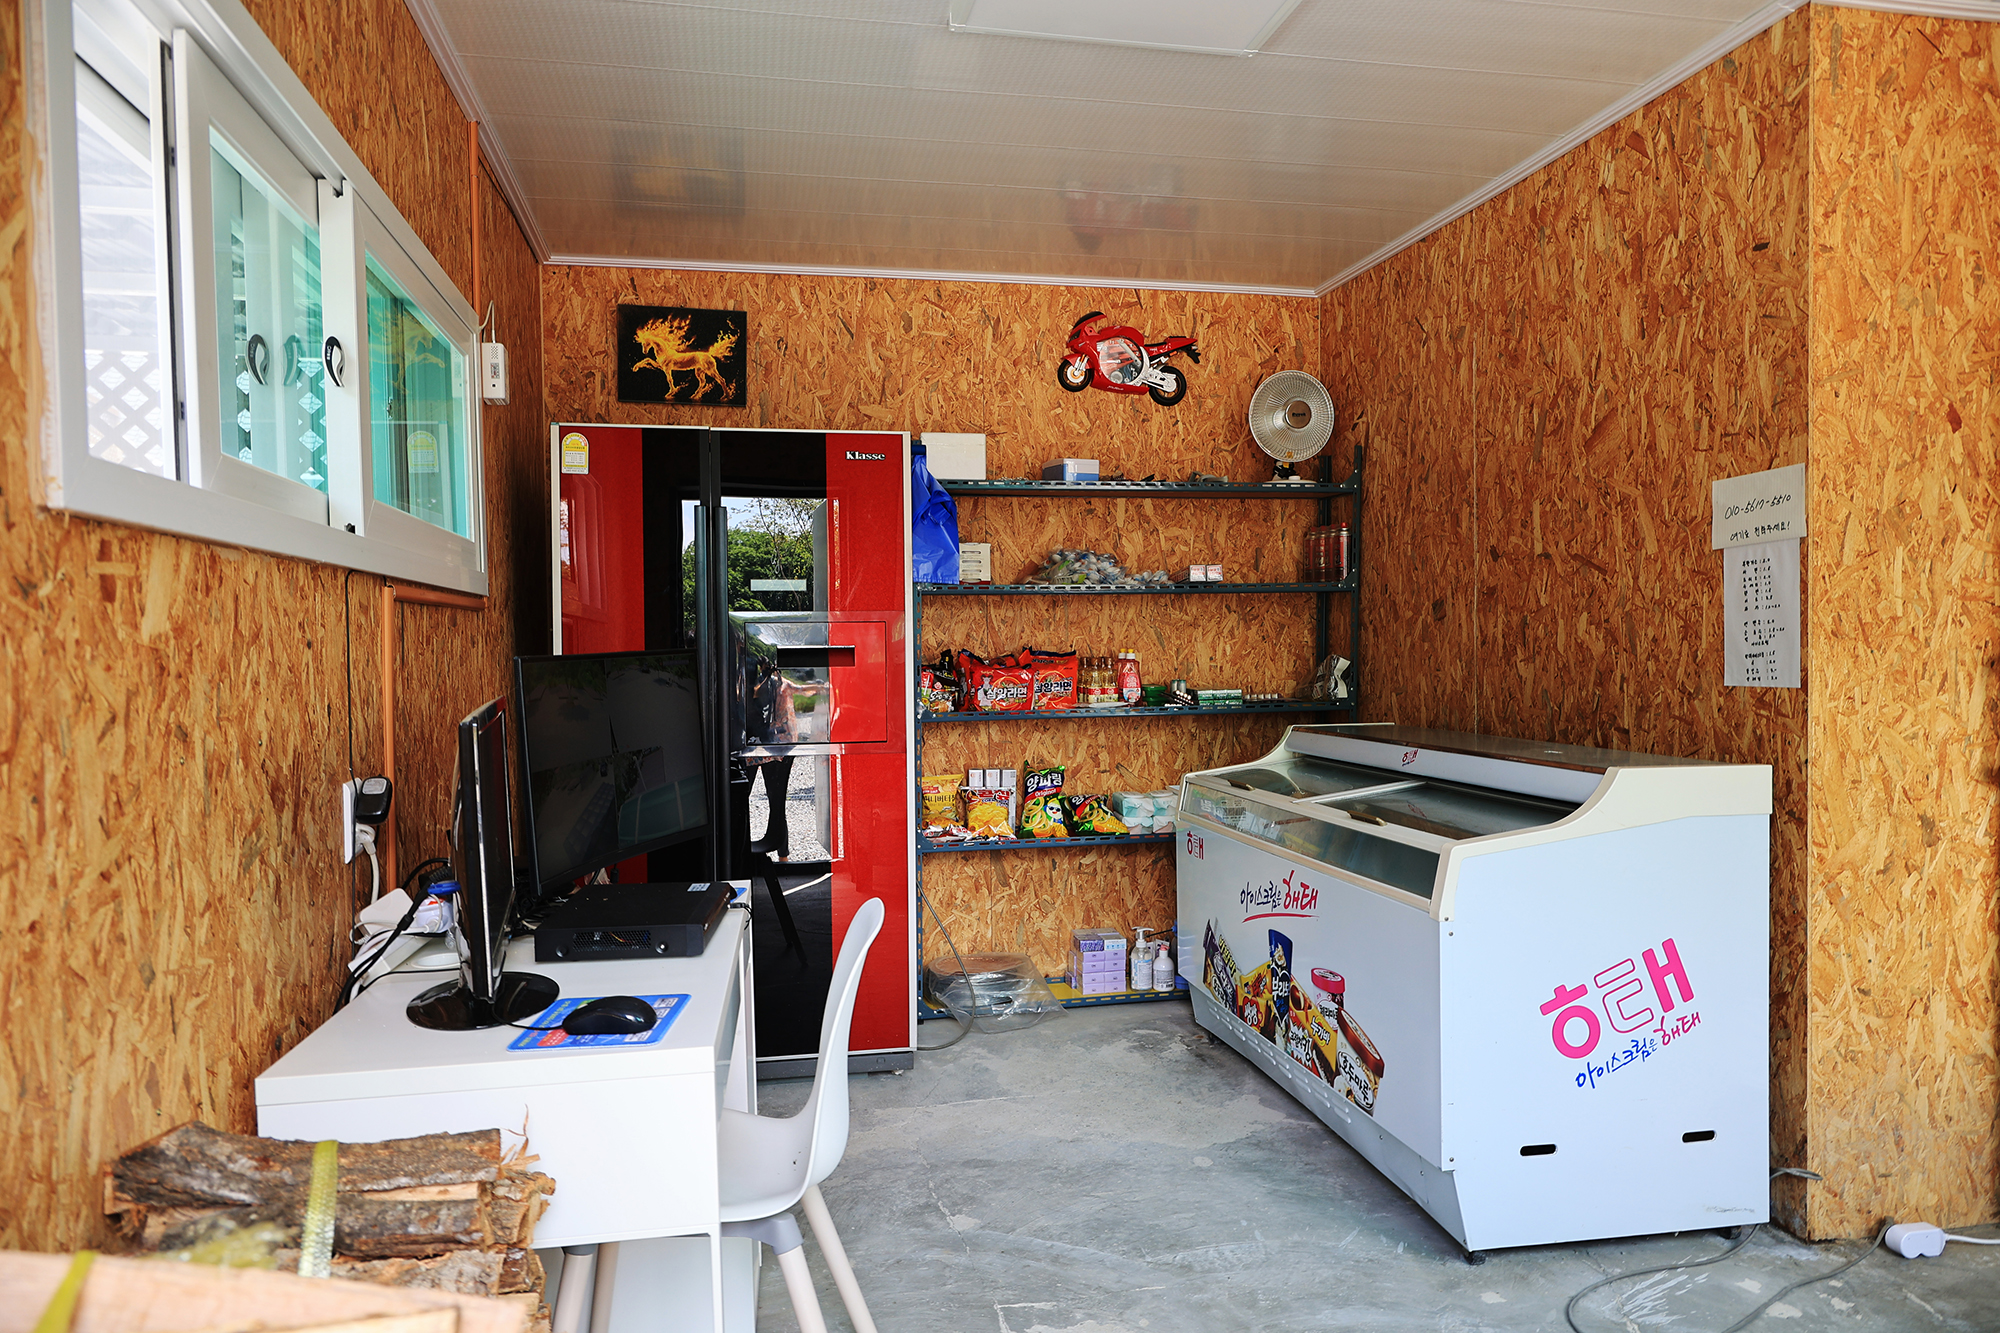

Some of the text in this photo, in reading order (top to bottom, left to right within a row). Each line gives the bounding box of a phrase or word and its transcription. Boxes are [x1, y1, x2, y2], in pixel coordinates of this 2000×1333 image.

[845, 450, 886, 461] Klasse
[987, 686, 1027, 699] 삼양라면
[1027, 773, 1063, 792] 양파링
[1034, 788, 1057, 797] Original
[1186, 830, 1204, 860] 해태
[1240, 869, 1319, 913] 아이스크림은 해태
[1540, 937, 1695, 1059] 해태
[1311, 1015, 1331, 1046] 누가바
[1575, 1012, 1701, 1089] 아이스크림은 해태
[1341, 1054, 1370, 1102] 호두마루
